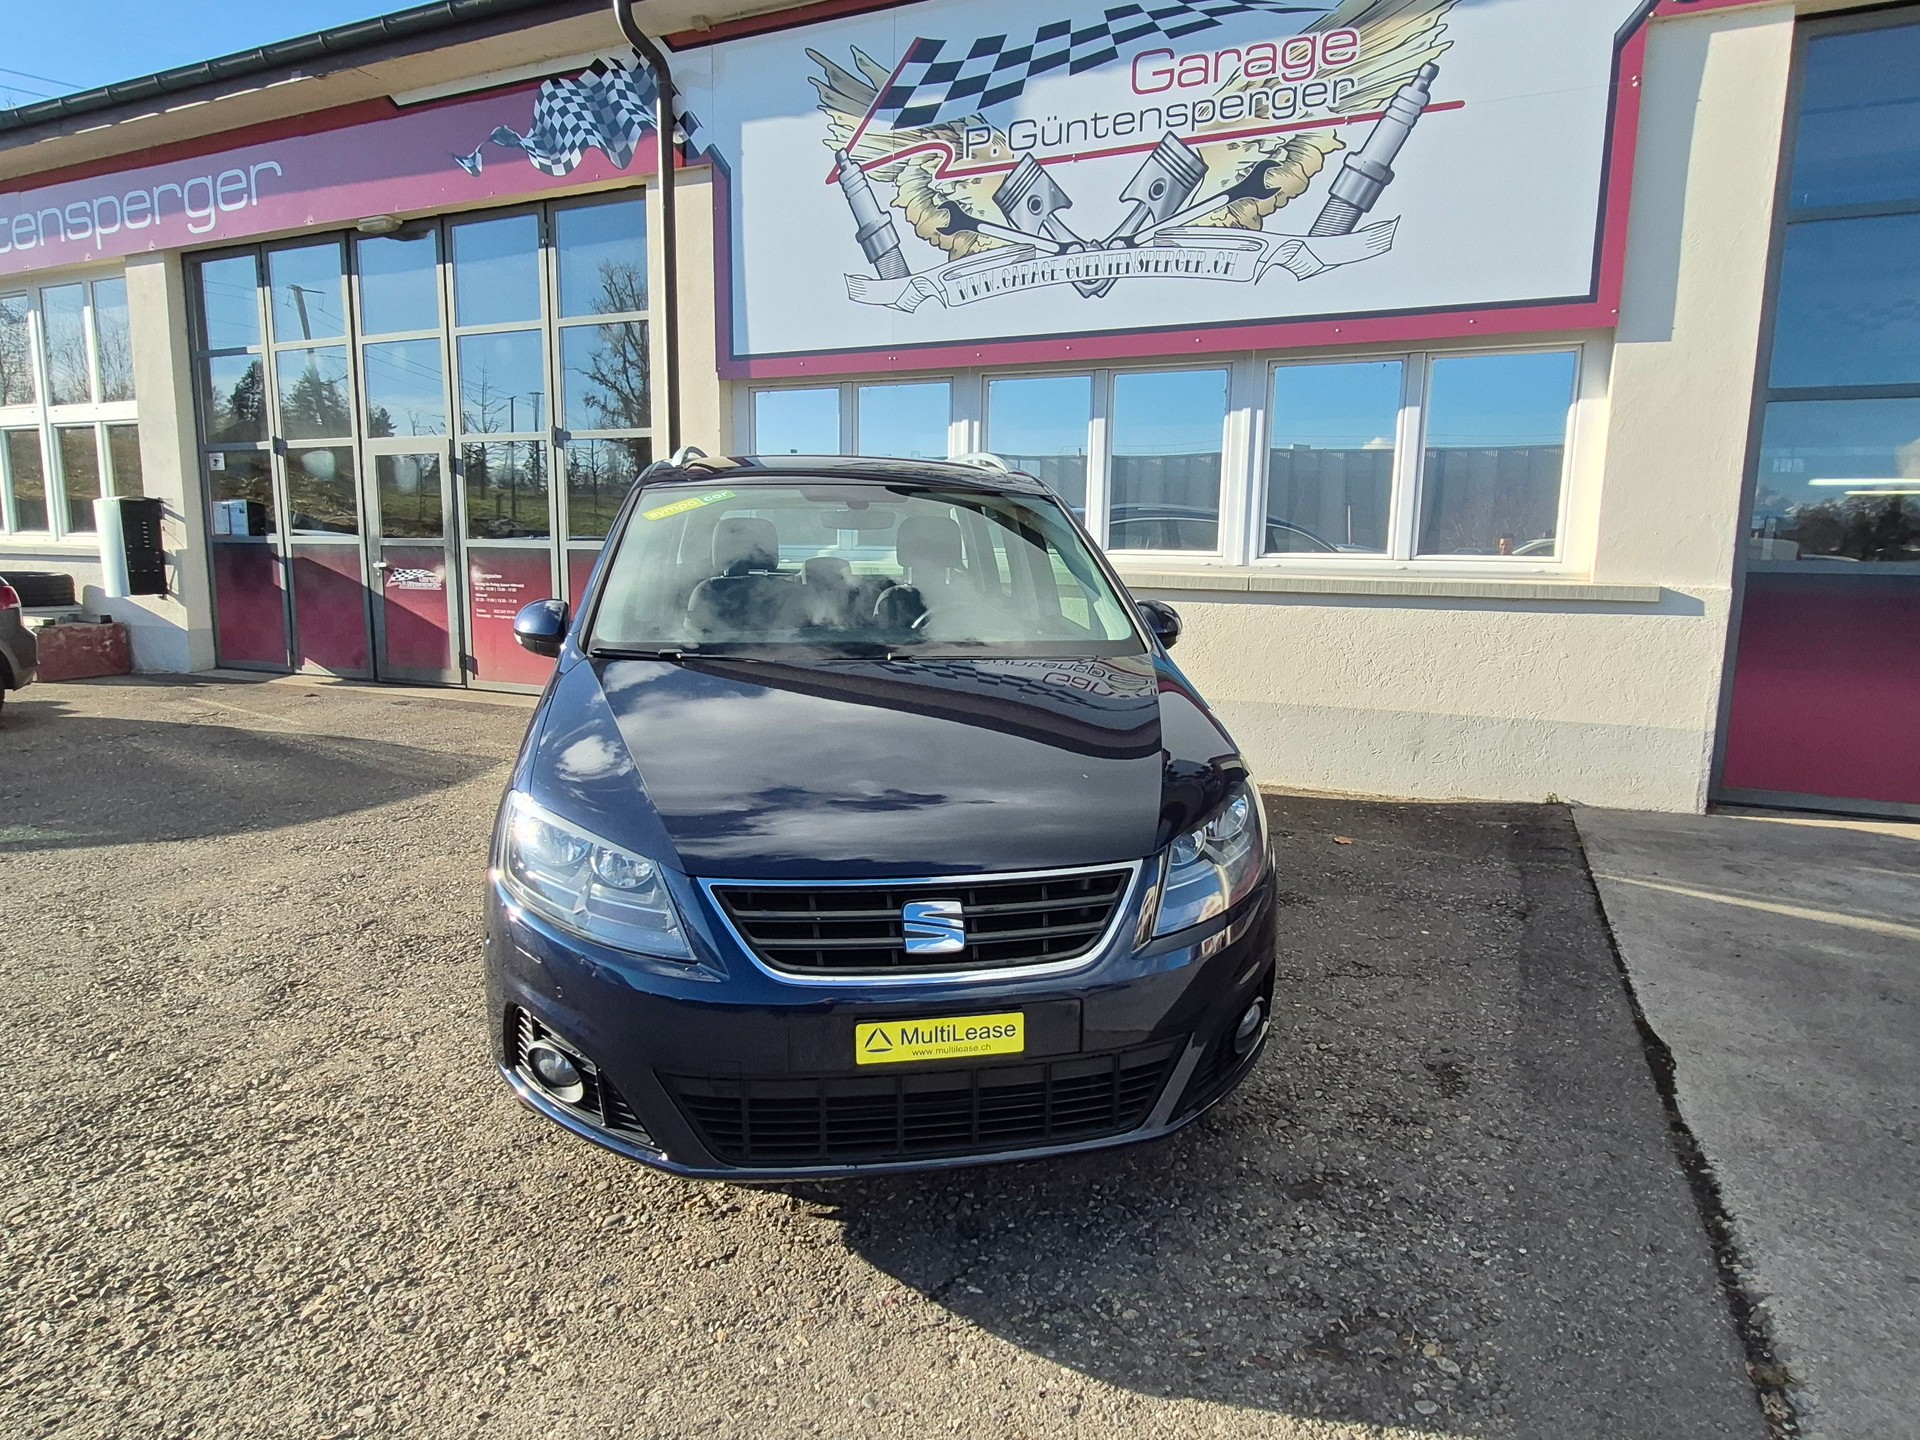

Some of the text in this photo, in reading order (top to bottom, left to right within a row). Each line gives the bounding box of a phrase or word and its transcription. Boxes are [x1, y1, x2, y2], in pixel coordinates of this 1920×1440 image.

[1131, 28, 1359, 96] Garage
[965, 76, 1356, 159] P. Güntensperger
[0, 161, 283, 253] ensperger
[900, 1023, 1017, 1046] MultiLease
[911, 1043, 992, 1057] www.multilease.ch
